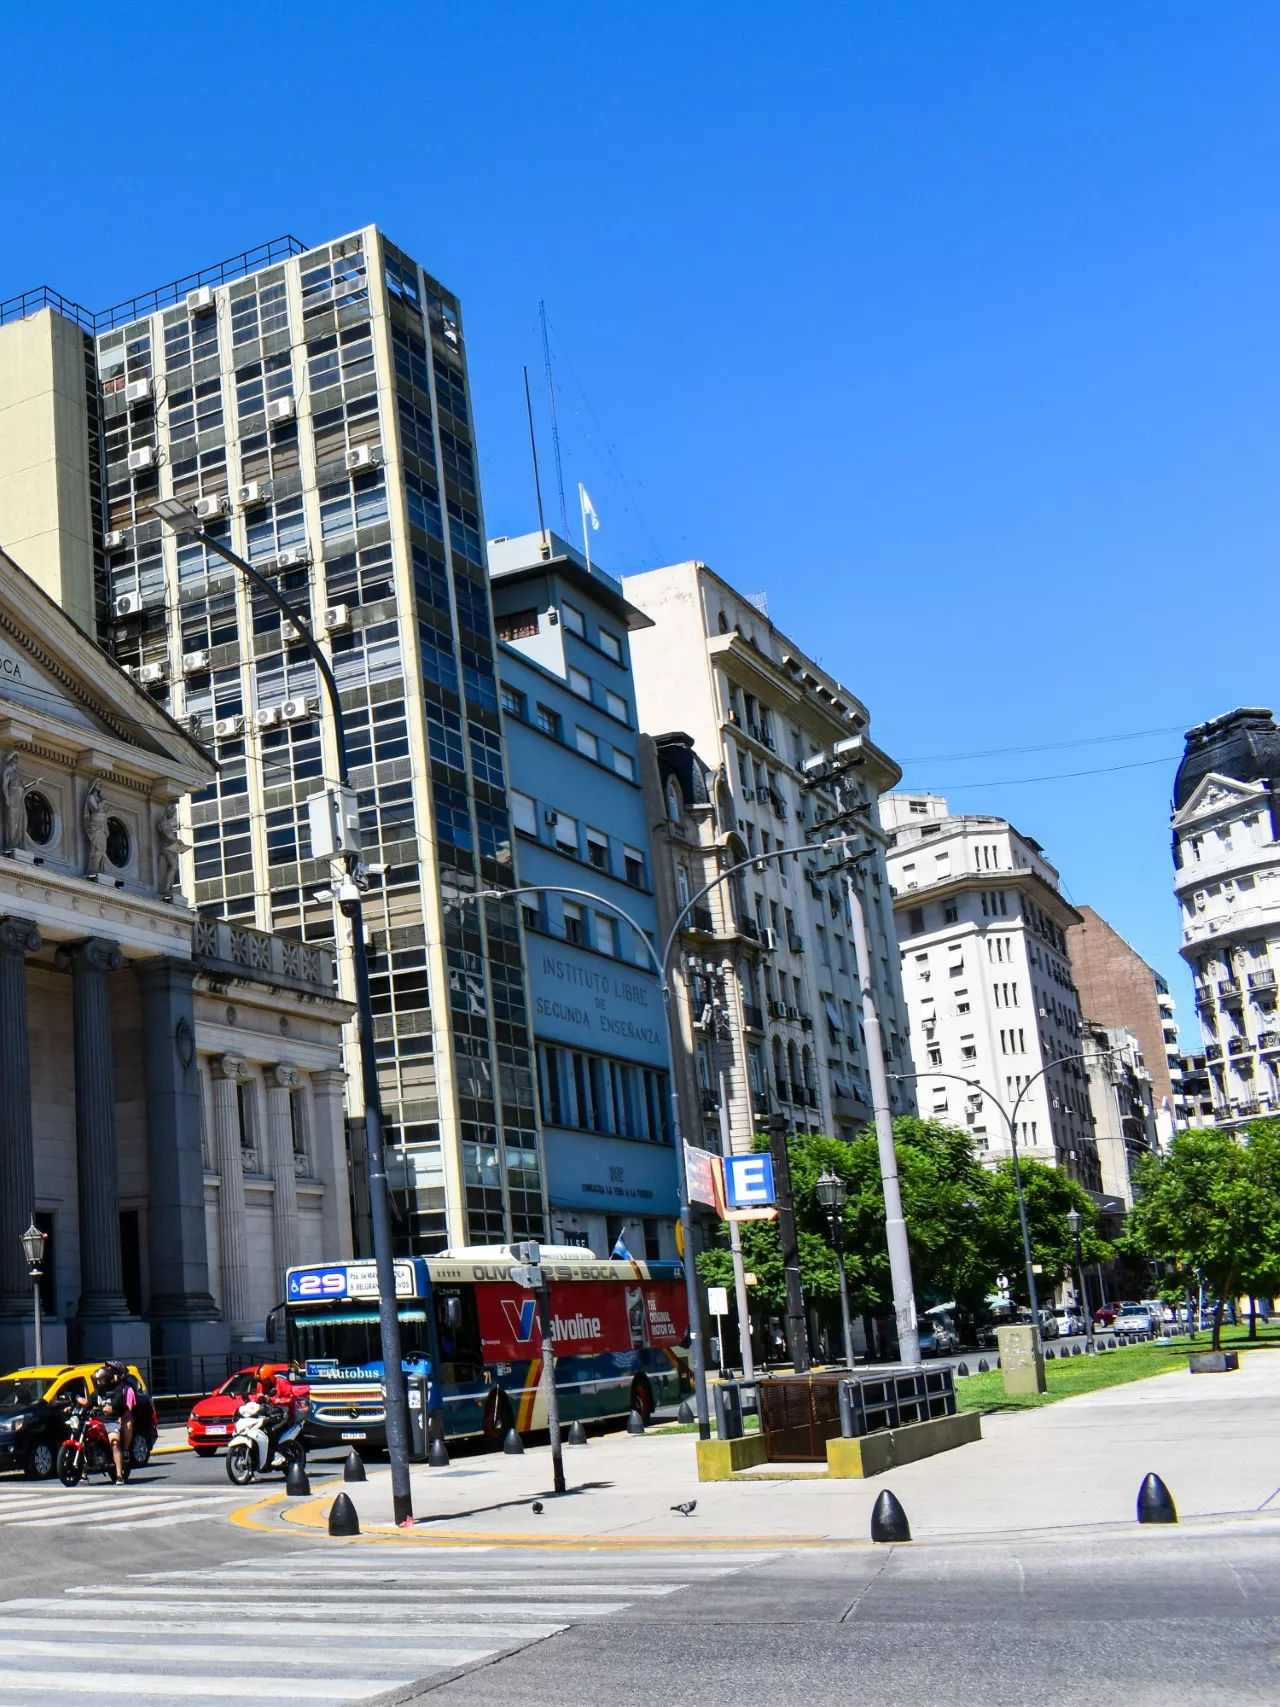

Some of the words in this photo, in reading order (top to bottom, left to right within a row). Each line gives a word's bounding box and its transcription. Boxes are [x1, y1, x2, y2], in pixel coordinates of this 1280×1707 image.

[543, 957, 609, 993] INSTITUTO
[614, 980, 647, 1006] LIBRE
[595, 997, 606, 1011] DE
[536, 996, 590, 1027] SEGUNDA
[599, 1015, 661, 1046] ENSEÑANZA
[732, 1159, 767, 1201] E
[299, 1273, 346, 1295] 29
[328, 1367, 380, 1379] Autobus
[483, 1371, 492, 1384] 71
